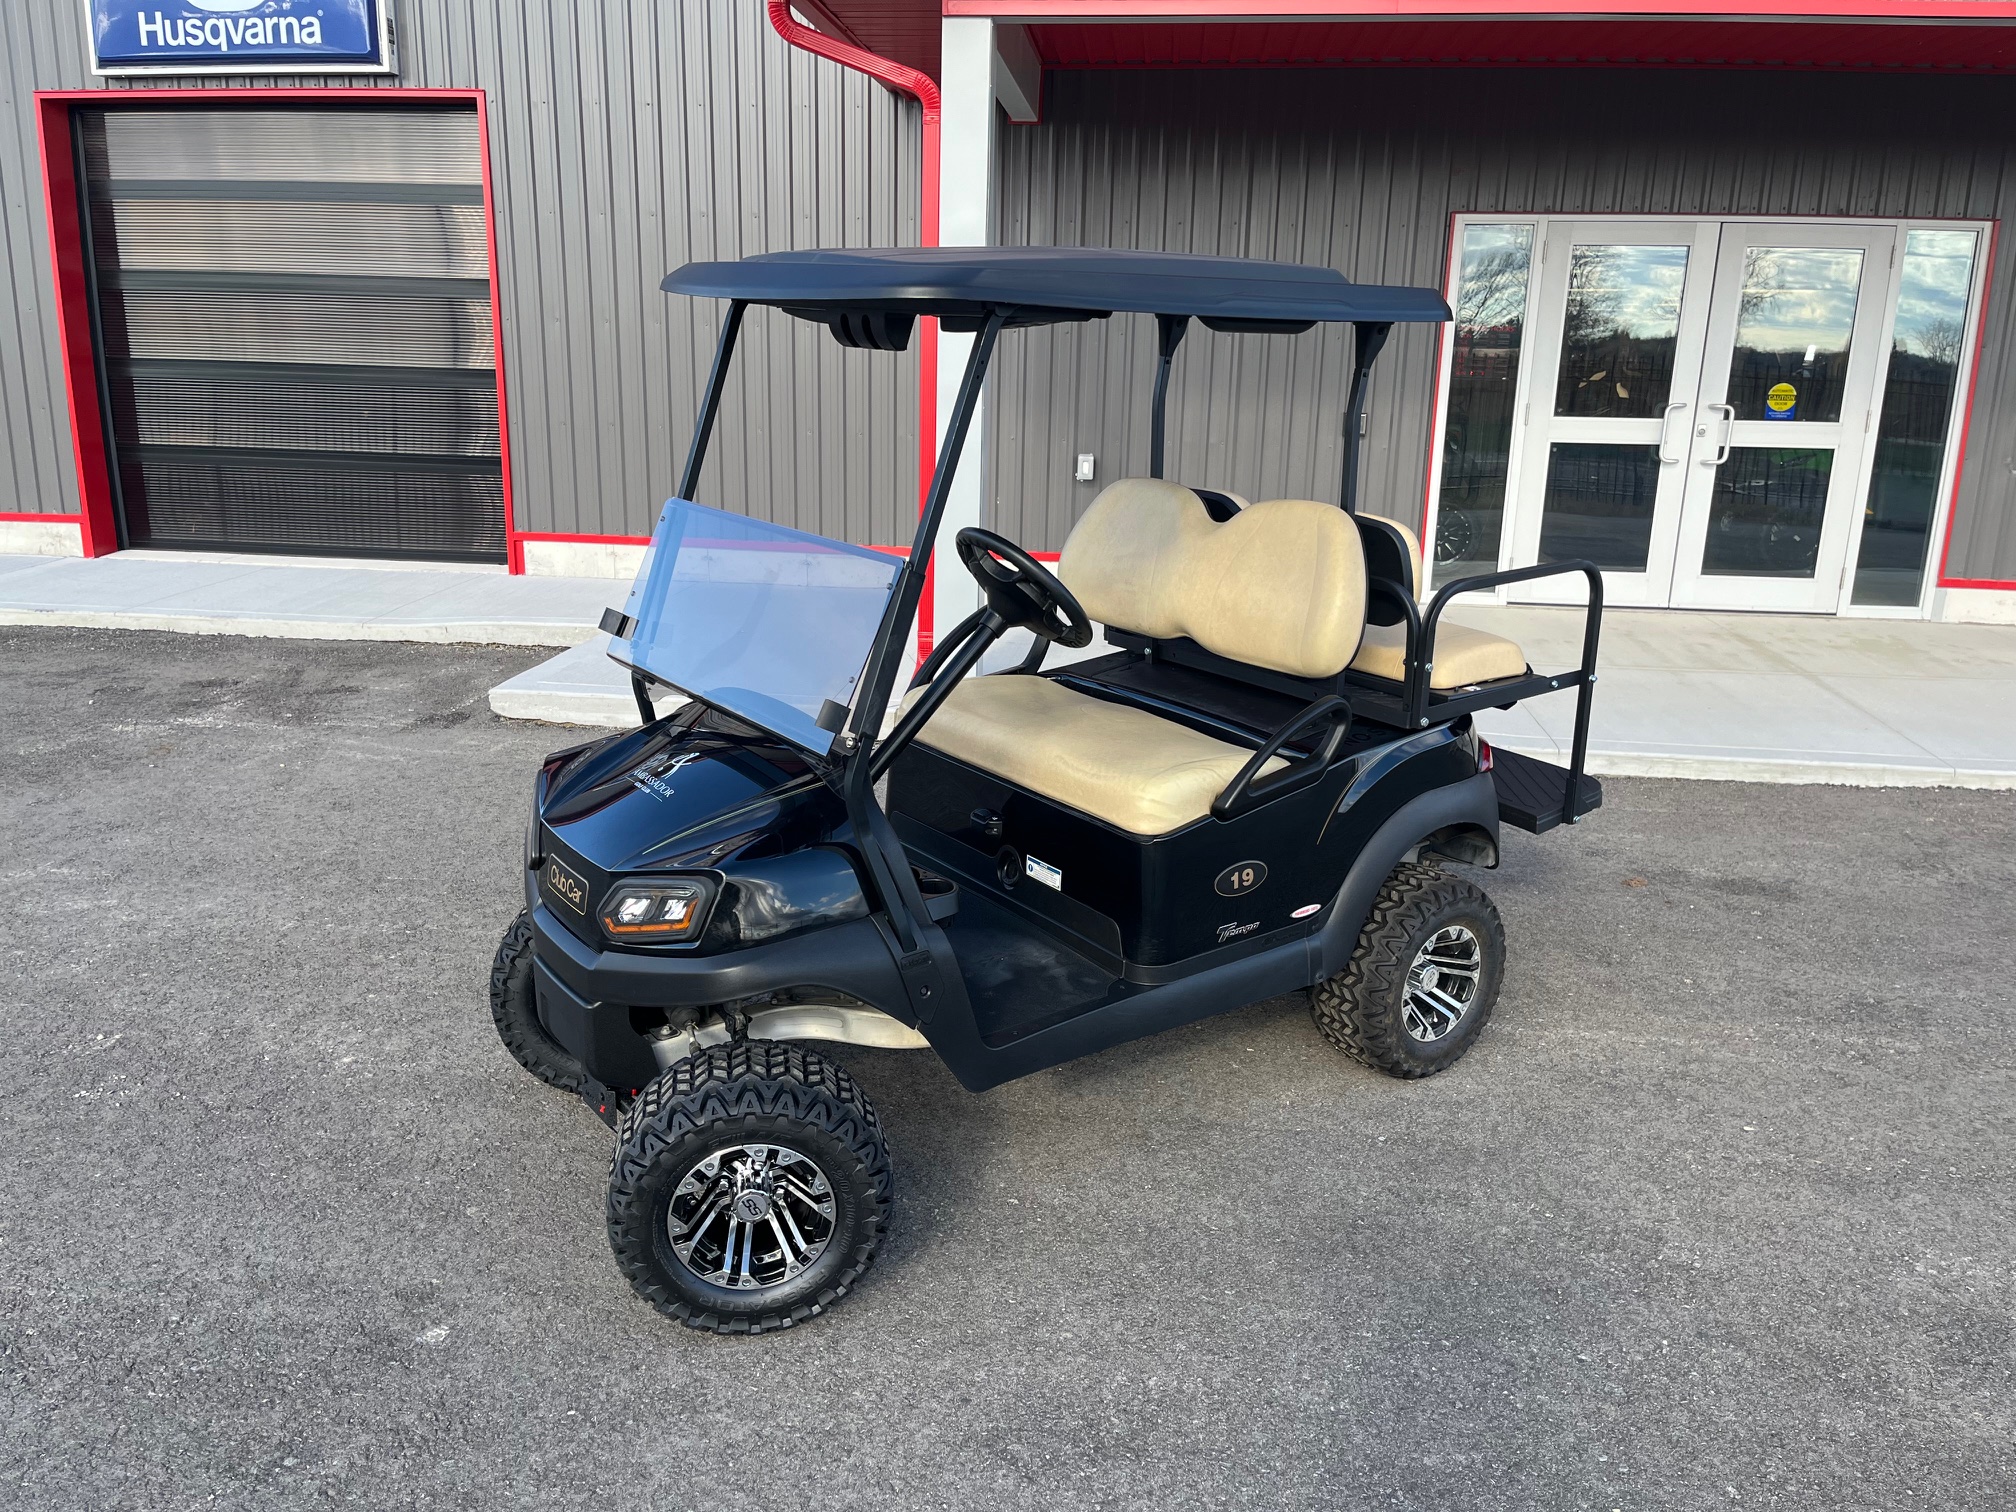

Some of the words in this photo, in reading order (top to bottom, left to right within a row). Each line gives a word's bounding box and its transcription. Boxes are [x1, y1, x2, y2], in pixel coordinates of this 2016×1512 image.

[137, 11, 322, 51] Husqvarna
[634, 769, 675, 798] AMBASSADOR
[551, 865, 566, 892] Club
[567, 878, 582, 903] Car
[1230, 868, 1254, 889] 19
